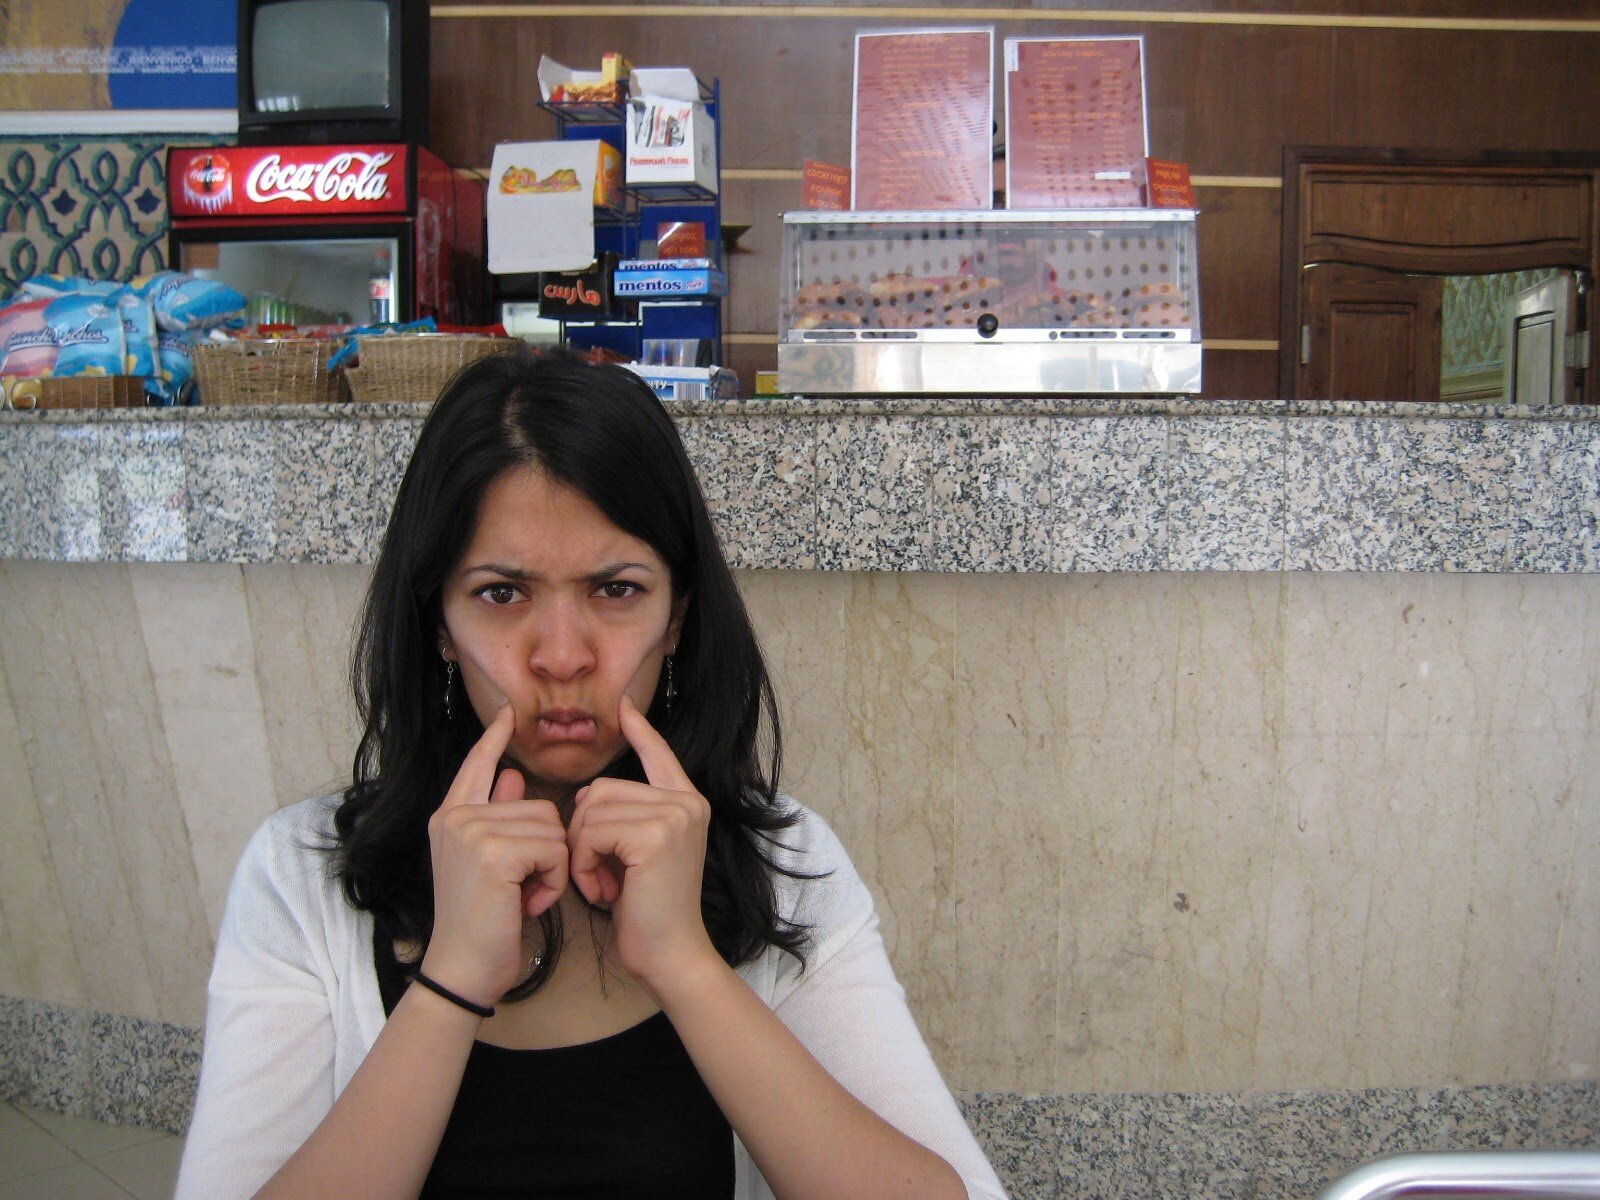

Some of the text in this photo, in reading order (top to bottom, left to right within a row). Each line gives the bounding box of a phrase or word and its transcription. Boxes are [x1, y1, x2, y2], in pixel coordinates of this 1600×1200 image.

[246, 152, 394, 203] Coca-Cola
[624, 260, 678, 270] mentos
[618, 279, 682, 292] mentos
